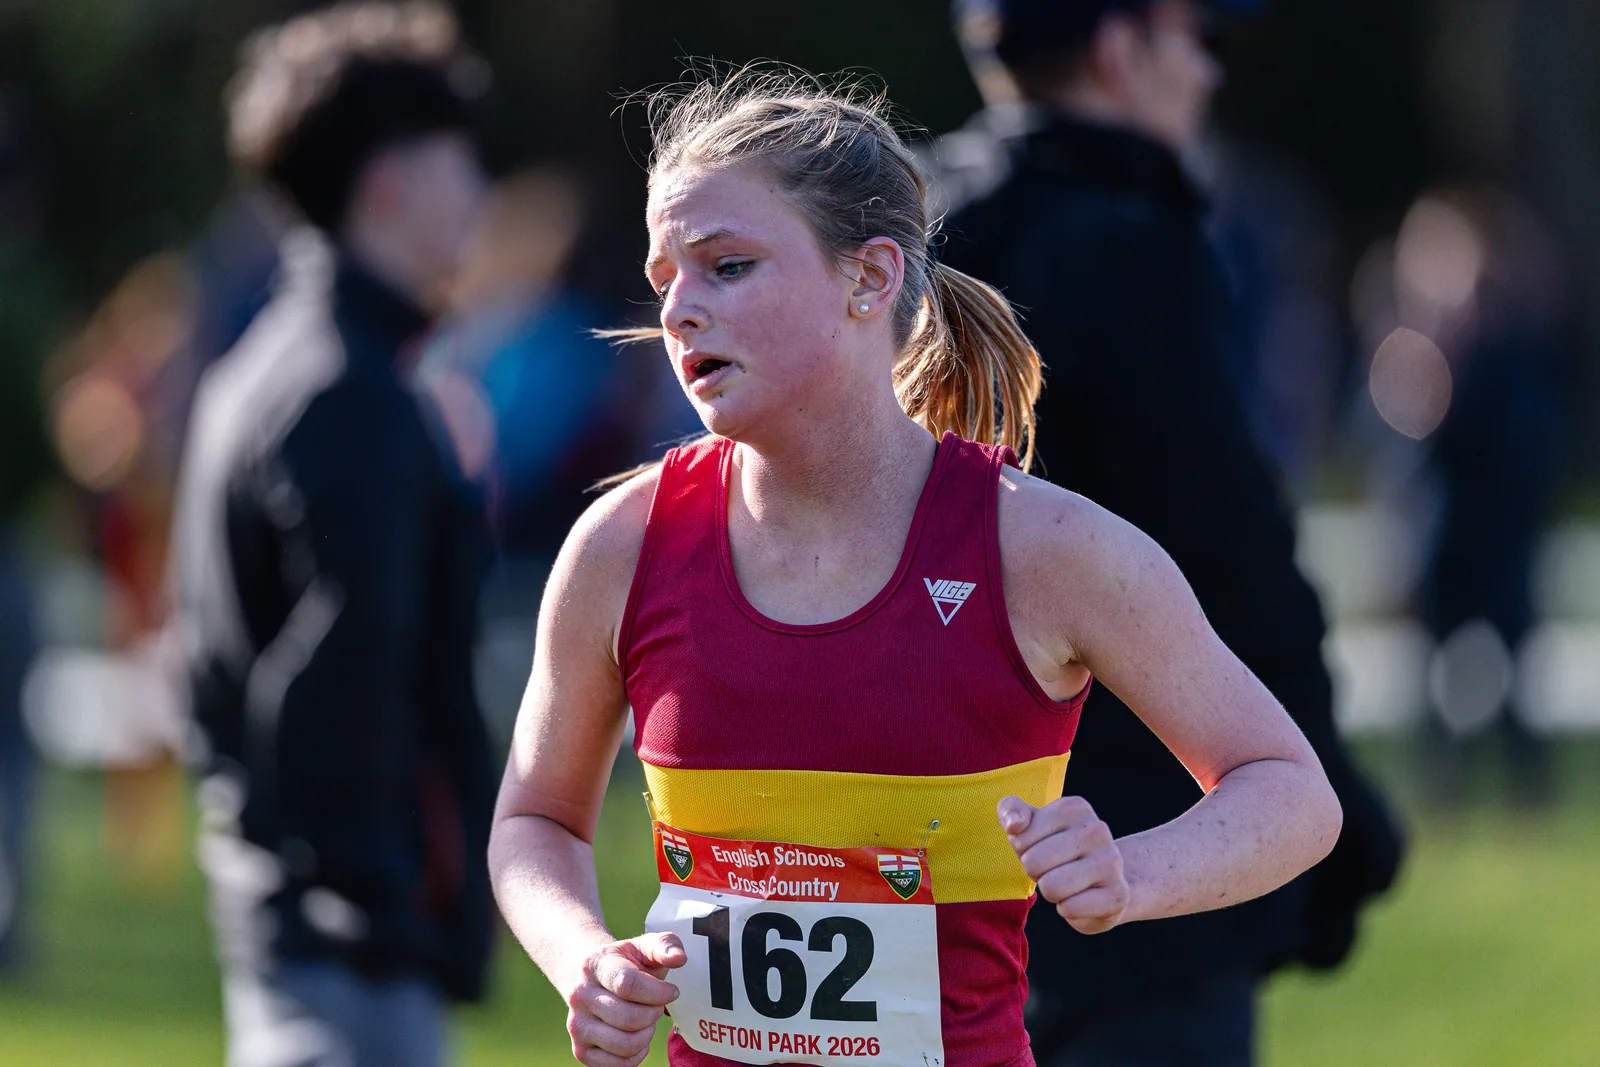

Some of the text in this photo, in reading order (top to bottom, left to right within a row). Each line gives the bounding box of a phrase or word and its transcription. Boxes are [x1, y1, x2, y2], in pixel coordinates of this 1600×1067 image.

[711, 845, 846, 868] English Schools
[727, 871, 840, 901] Cross Country
[692, 904, 878, 1022] 162
[698, 1019, 881, 1057] SEFTON PARK 2026
